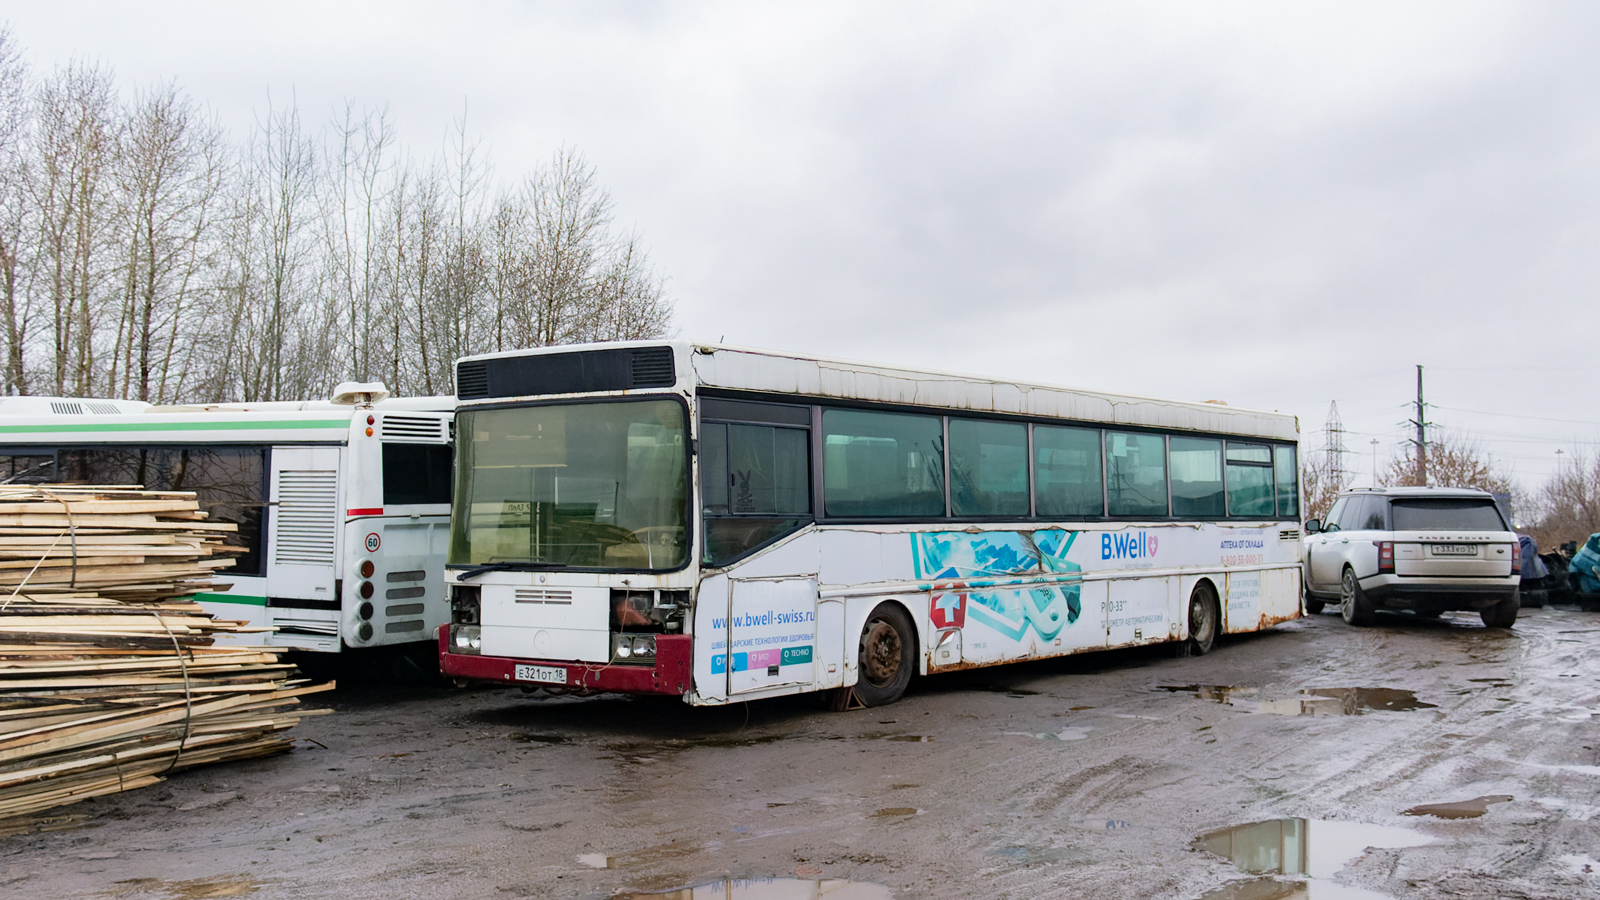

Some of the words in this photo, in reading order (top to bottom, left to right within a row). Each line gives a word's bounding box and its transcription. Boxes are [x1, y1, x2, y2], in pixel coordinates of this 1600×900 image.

[368, 537, 378, 548] 60
[1101, 531, 1146, 560] B.Well
[1220, 541, 1238, 549] АПТЕКА
[1239, 541, 1245, 549] ОТ
[1245, 540, 1264, 548] СКЛАДА
[755, 636, 788, 646] ТЕХНОЛОГИИ
[789, 633, 814, 643] ЗДОРОВЬЯ
[758, 653, 770, 661] MED
[791, 649, 810, 657] TECHNO
[518, 666, 552, 681] Е321ОТ
[555, 669, 563, 679] 18
